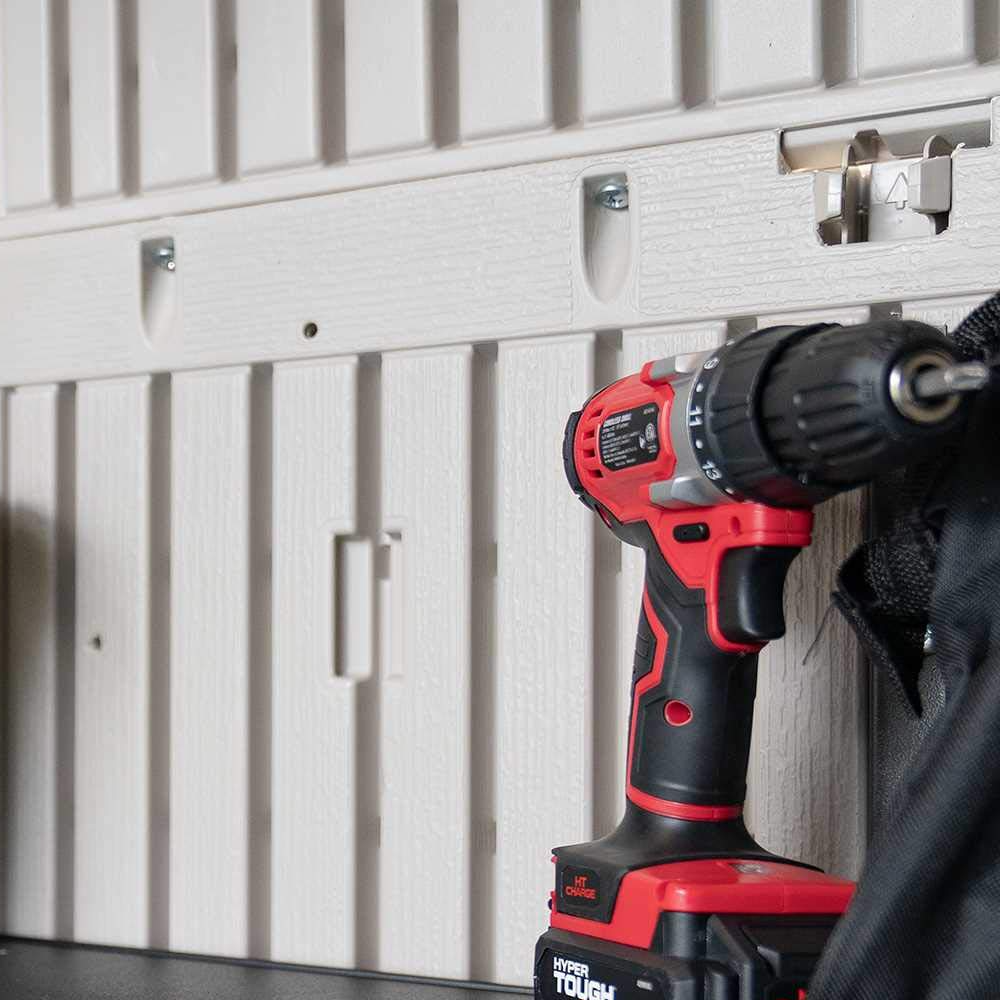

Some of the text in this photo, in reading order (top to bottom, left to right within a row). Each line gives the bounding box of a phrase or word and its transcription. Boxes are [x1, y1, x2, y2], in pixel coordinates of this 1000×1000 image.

[688, 405, 703, 427] 11
[702, 461, 722, 481] 13
[574, 875, 588, 887] HT
[565, 886, 597, 900] CHARGE
[553, 956, 590, 978] HYPER
